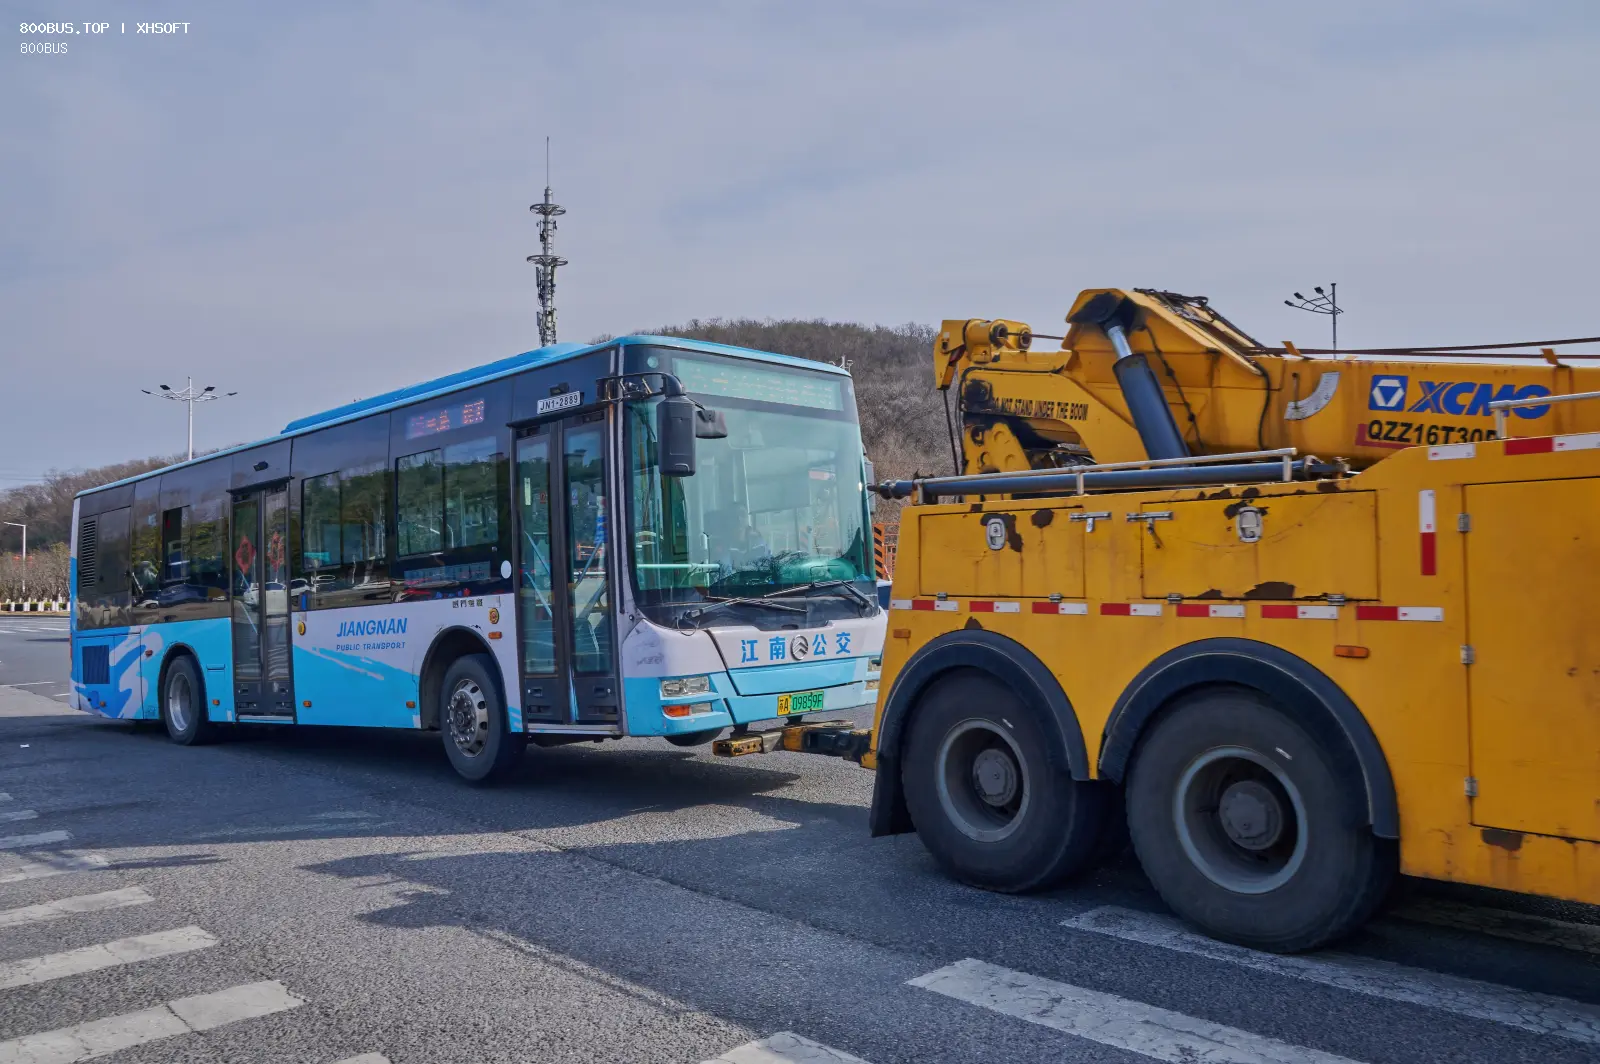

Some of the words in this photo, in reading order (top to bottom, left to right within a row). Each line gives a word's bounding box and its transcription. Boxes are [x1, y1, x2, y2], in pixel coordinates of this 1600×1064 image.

[1015, 398, 1033, 416] STAND
[1034, 400, 1055, 418] UNDER
[1057, 400, 1069, 419] THE
[1069, 402, 1089, 421] BOOM
[1407, 380, 1552, 420] XCMG
[336, 617, 408, 638] JIANGNAN
[336, 642, 360, 652] PUBLIC
[363, 641, 406, 651] TRANSPORT
